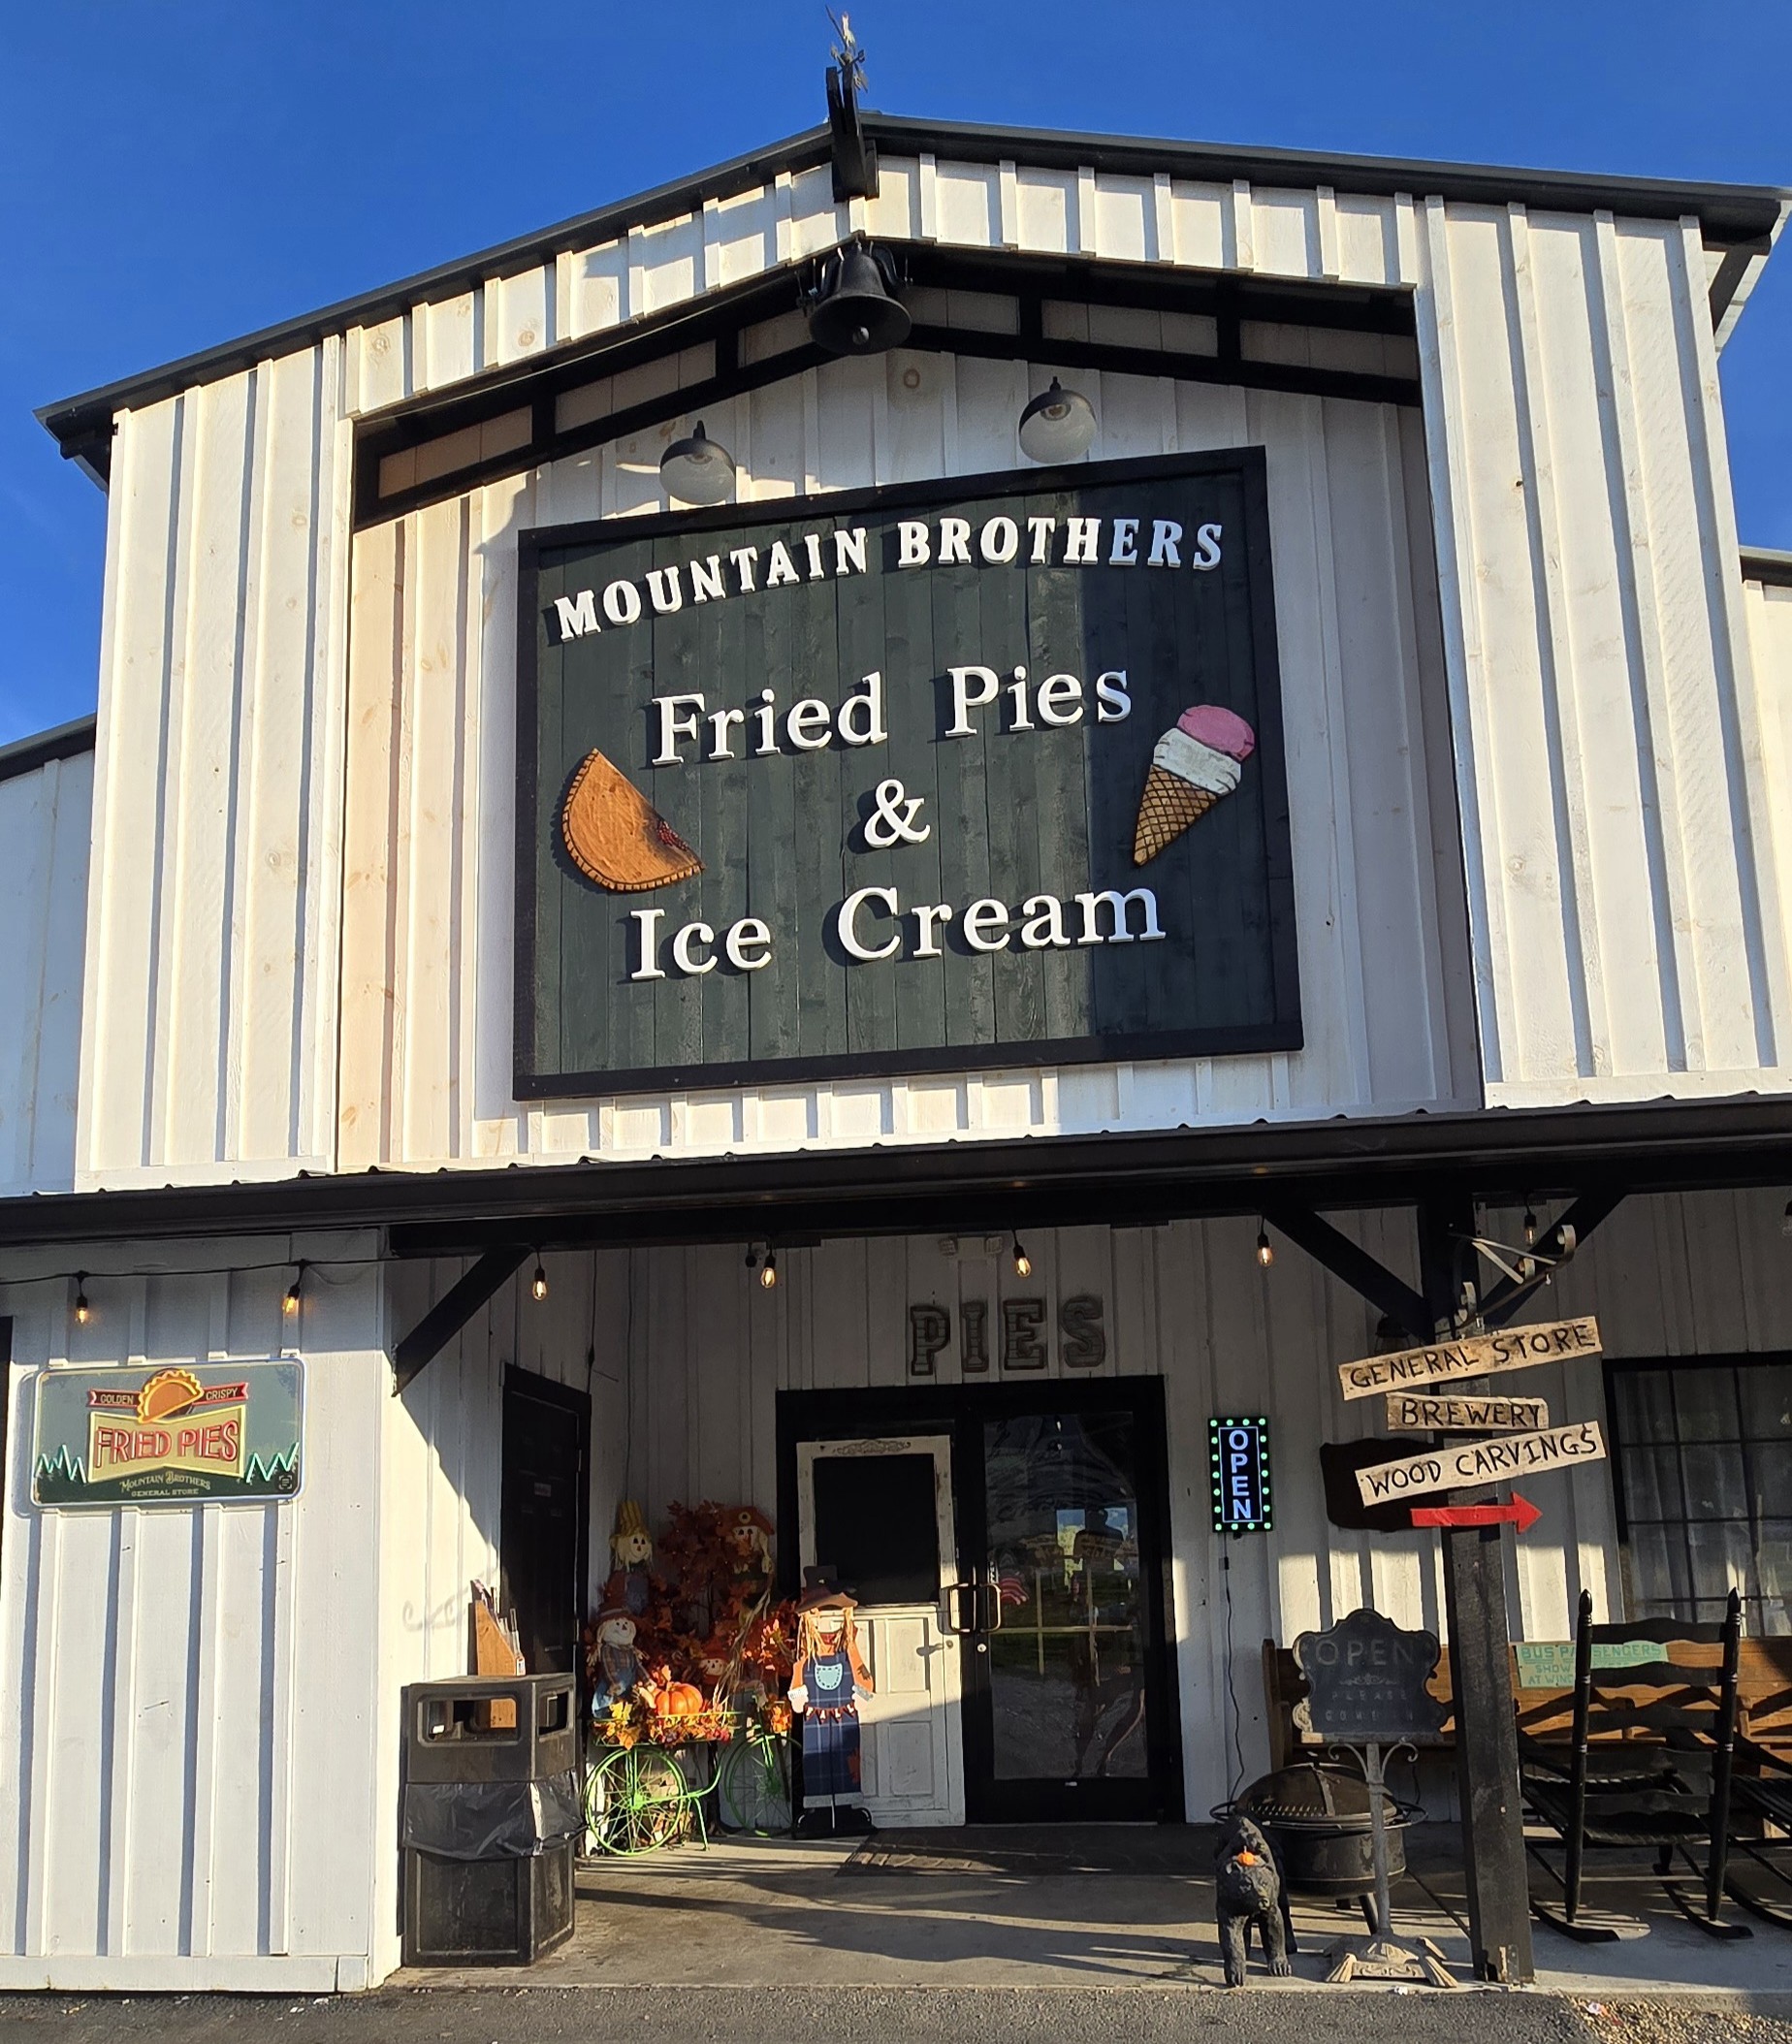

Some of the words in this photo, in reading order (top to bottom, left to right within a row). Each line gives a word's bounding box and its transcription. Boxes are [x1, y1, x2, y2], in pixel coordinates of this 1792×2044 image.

[555, 527, 868, 642] MOUNTAIN
[897, 516, 1224, 571] BROTHERS
[651, 671, 888, 765] Fried
[944, 665, 1133, 737] Pies
[863, 779, 931, 848] &
[629, 908, 772, 980] Ice
[837, 885, 1166, 961] Cream
[910, 1295, 1106, 1376] PIES
[1350, 1345, 1480, 1388] GENERAL
[1491, 1325, 1596, 1364] STORE
[100, 1393, 134, 1405] GOLDEN
[206, 1388, 239, 1401] CRISPY
[1401, 1401, 1541, 1427] BREWERY
[94, 1426, 173, 1468] FRIED
[177, 1420, 239, 1462] PIES
[1366, 1459, 1442, 1497] WOOD
[1456, 1425, 1597, 1476] CARVINGS
[119, 1474, 165, 1493] MOUNTAIN
[165, 1471, 211, 1491] BROTHERS
[1229, 1429, 1252, 1520] OPEN
[1316, 1639, 1415, 1666] OPEN
[1521, 1646, 1554, 1659] BUS
[1560, 1645, 1662, 1658] PSENGERS
[1536, 1664, 1571, 1674] SHOW
[1331, 1690, 1407, 1701] PLEASE
[1528, 1675, 1541, 1685] AT
